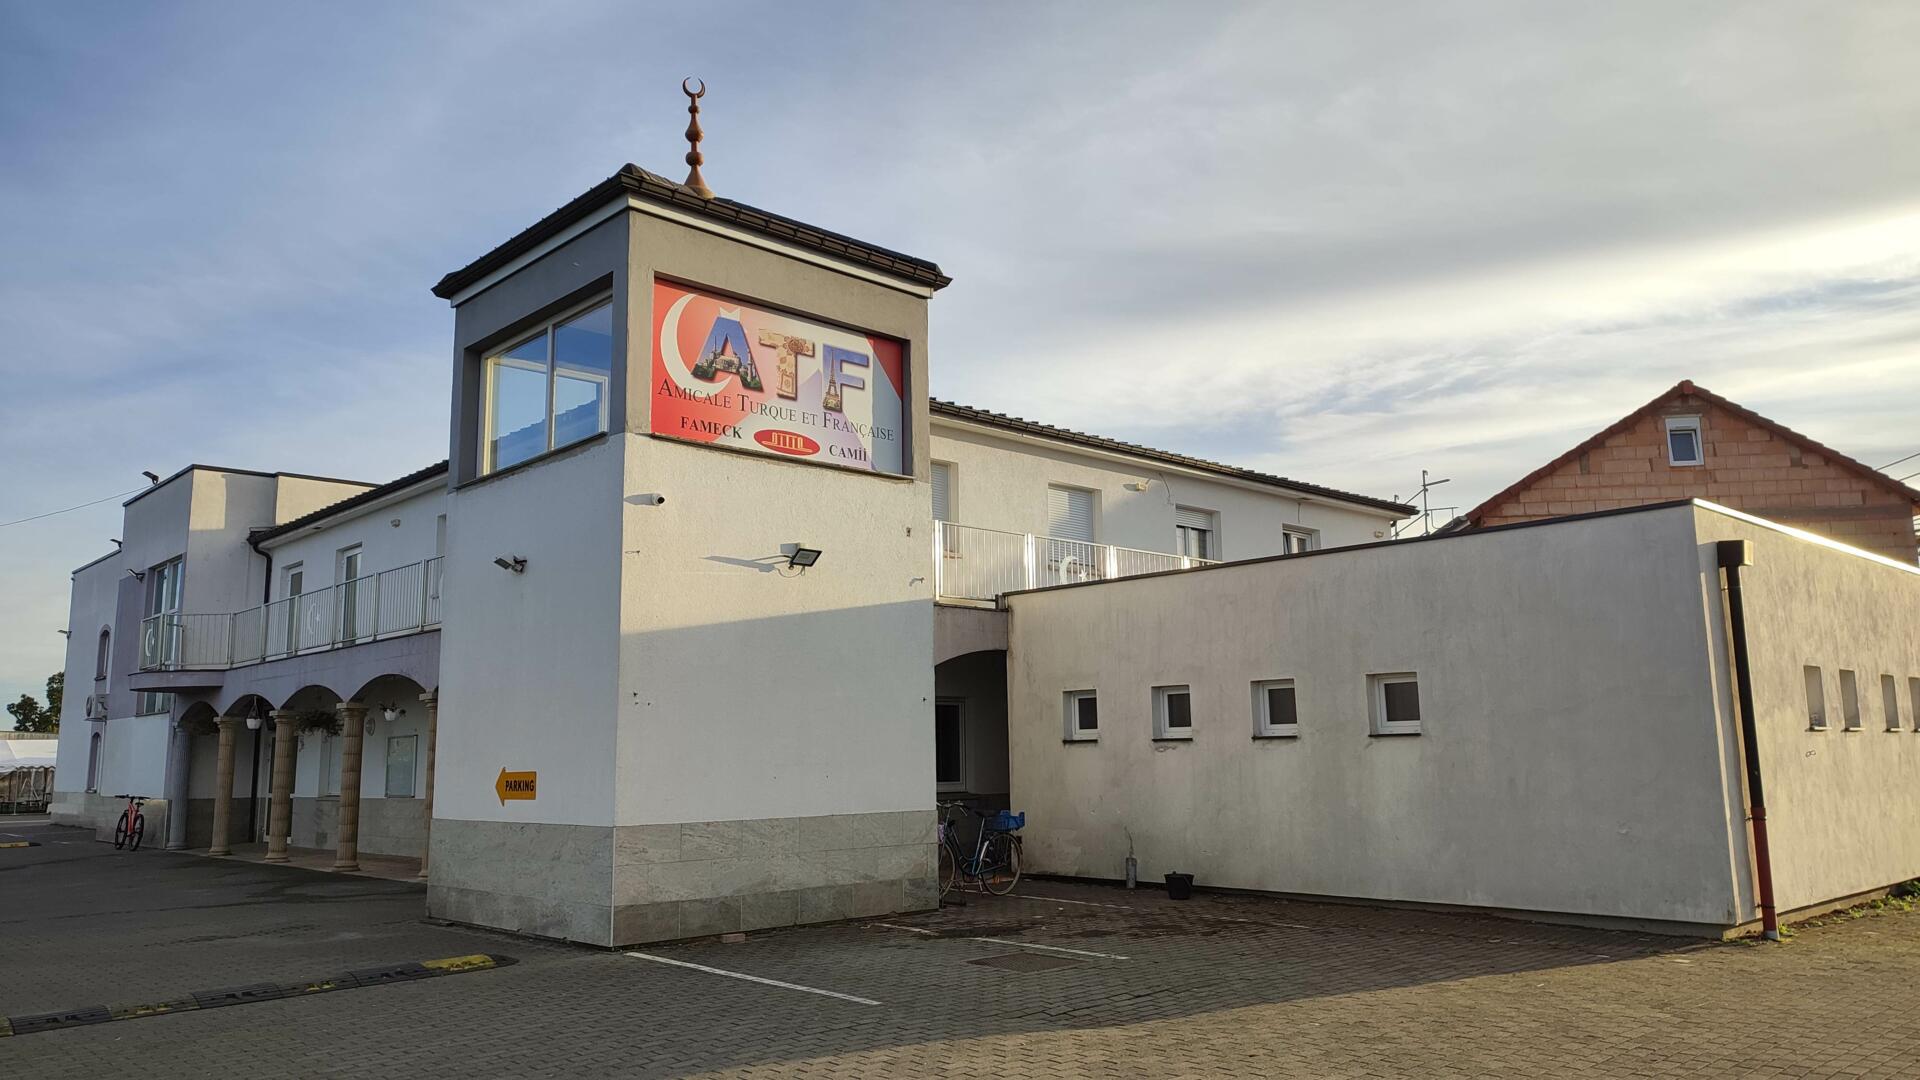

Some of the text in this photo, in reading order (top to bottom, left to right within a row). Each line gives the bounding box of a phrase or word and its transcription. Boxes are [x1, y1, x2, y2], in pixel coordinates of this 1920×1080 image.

[691, 308, 870, 413] ATF
[657, 378, 895, 442] AMICALE TURQUE ET FRANÇAISE
[680, 416, 743, 440] FAMECK
[505, 779, 535, 792] PARKING
